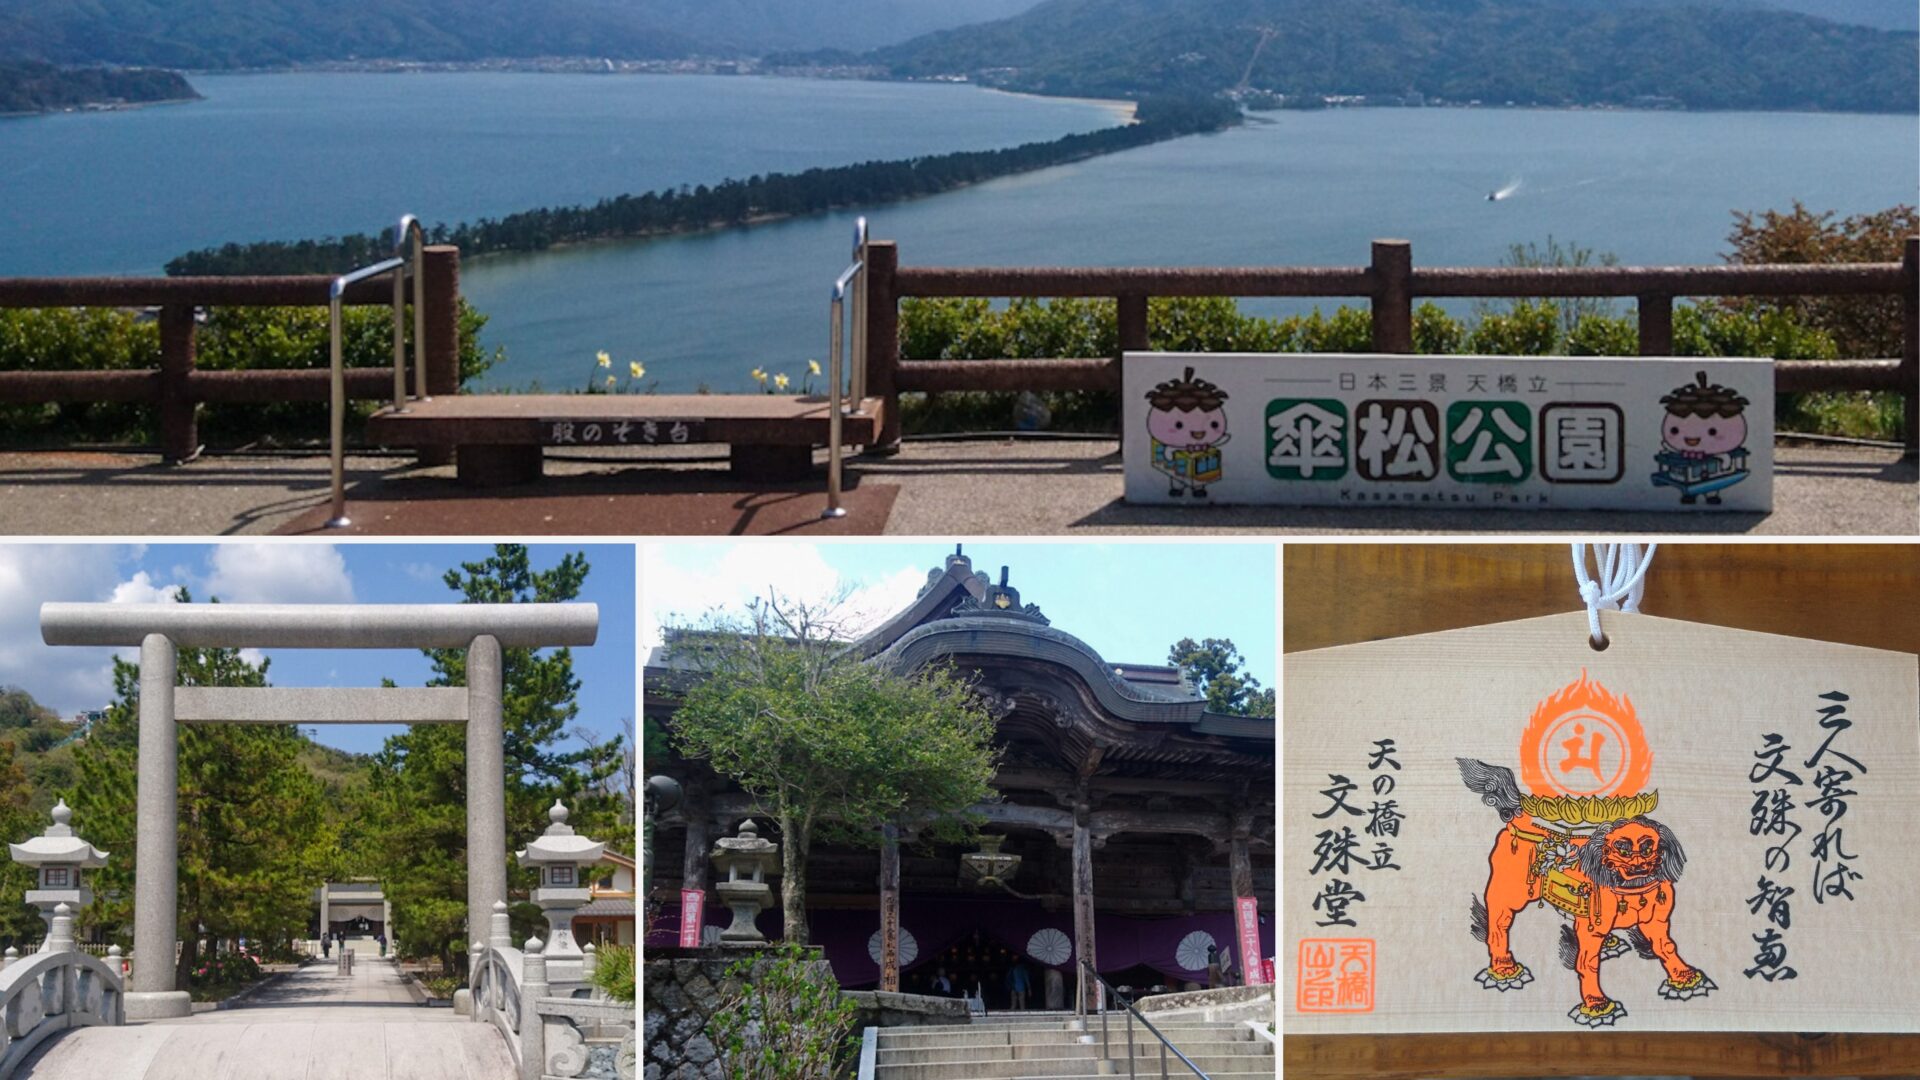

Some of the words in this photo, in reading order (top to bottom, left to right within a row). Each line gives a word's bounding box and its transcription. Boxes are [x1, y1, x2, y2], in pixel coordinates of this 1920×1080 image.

[1338, 372, 1448, 393] 日本三景
[1466, 373, 1549, 394] 天橋立
[1267, 402, 1621, 480] 傘松公園
[1340, 489, 1476, 503] Kasamatsu
[1492, 491, 1550, 504] Park
[1364, 738, 1406, 871] 天の橋立
[1803, 690, 1868, 905] 三人寄れば
[1309, 773, 1370, 928] 文殊堂
